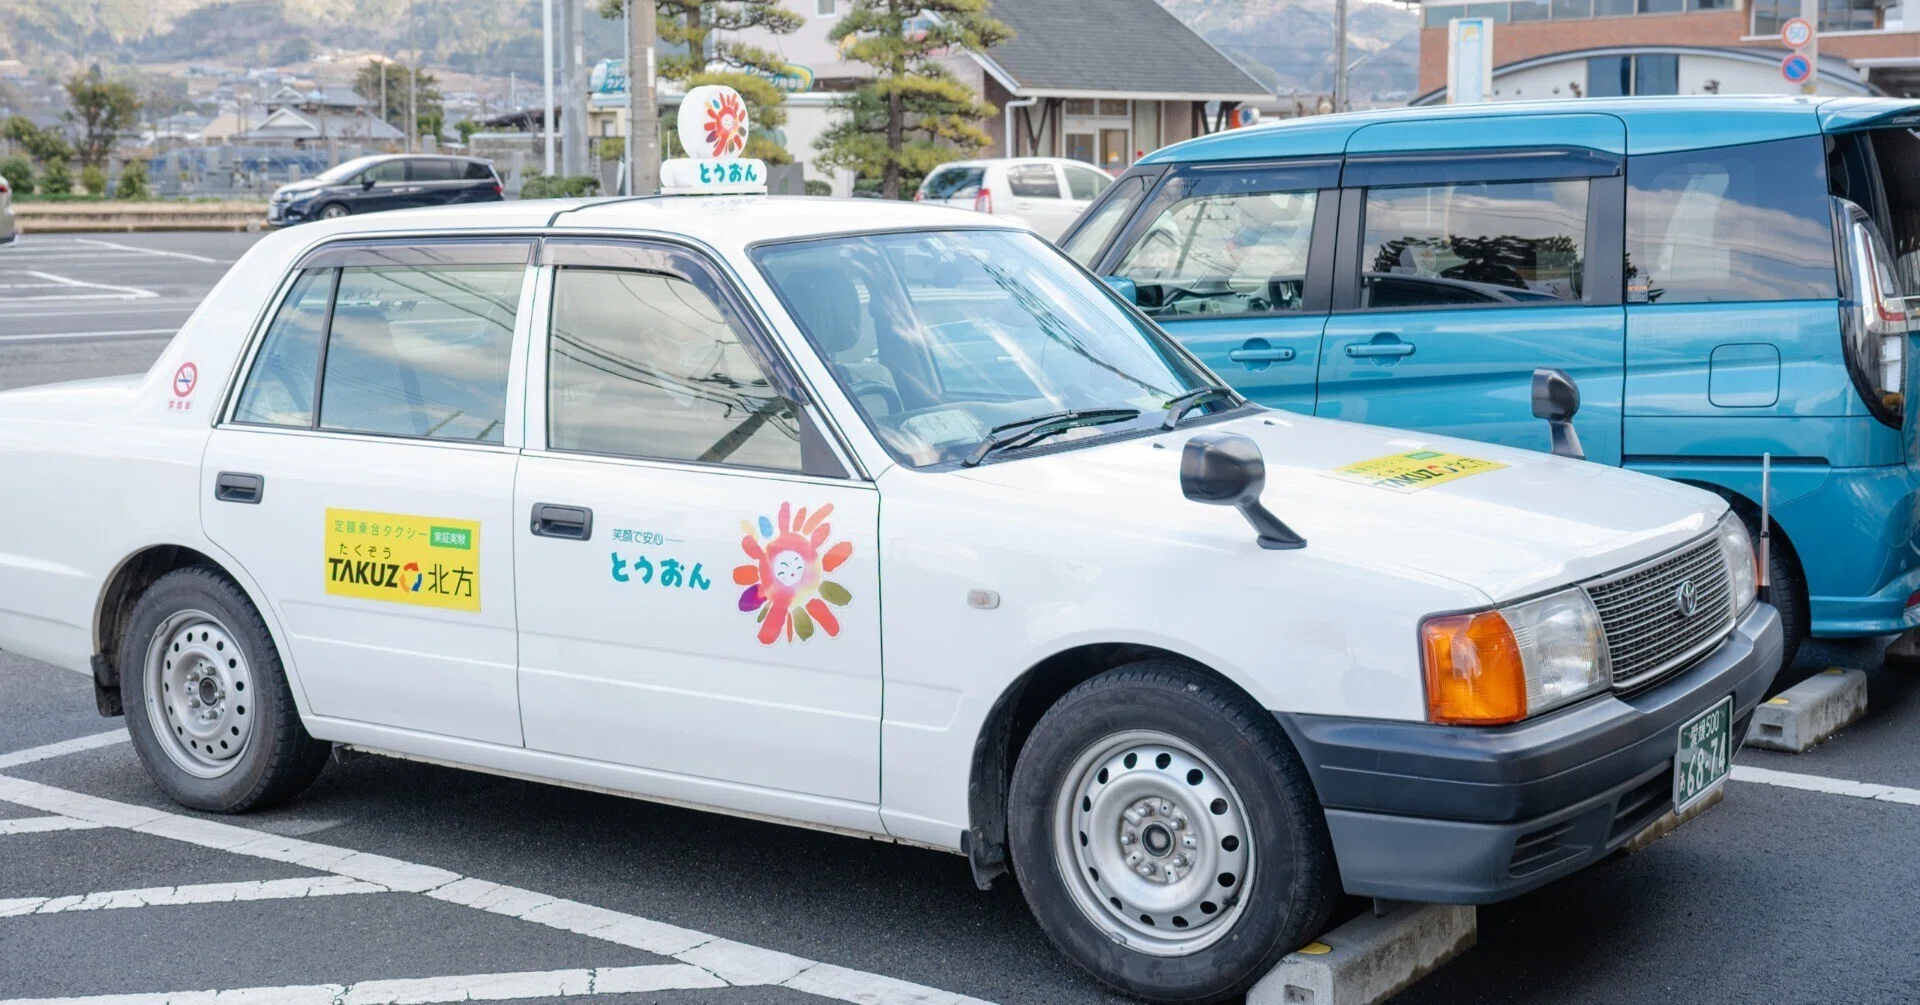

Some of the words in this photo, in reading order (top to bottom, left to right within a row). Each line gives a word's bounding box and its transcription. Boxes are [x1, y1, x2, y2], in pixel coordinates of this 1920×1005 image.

[700, 163, 757, 184] とうおん
[334, 520, 428, 540] 定額乗合タクシー
[339, 542, 391, 559] たくぞう
[428, 563, 474, 597] 北方
[611, 552, 711, 591] とうおん
